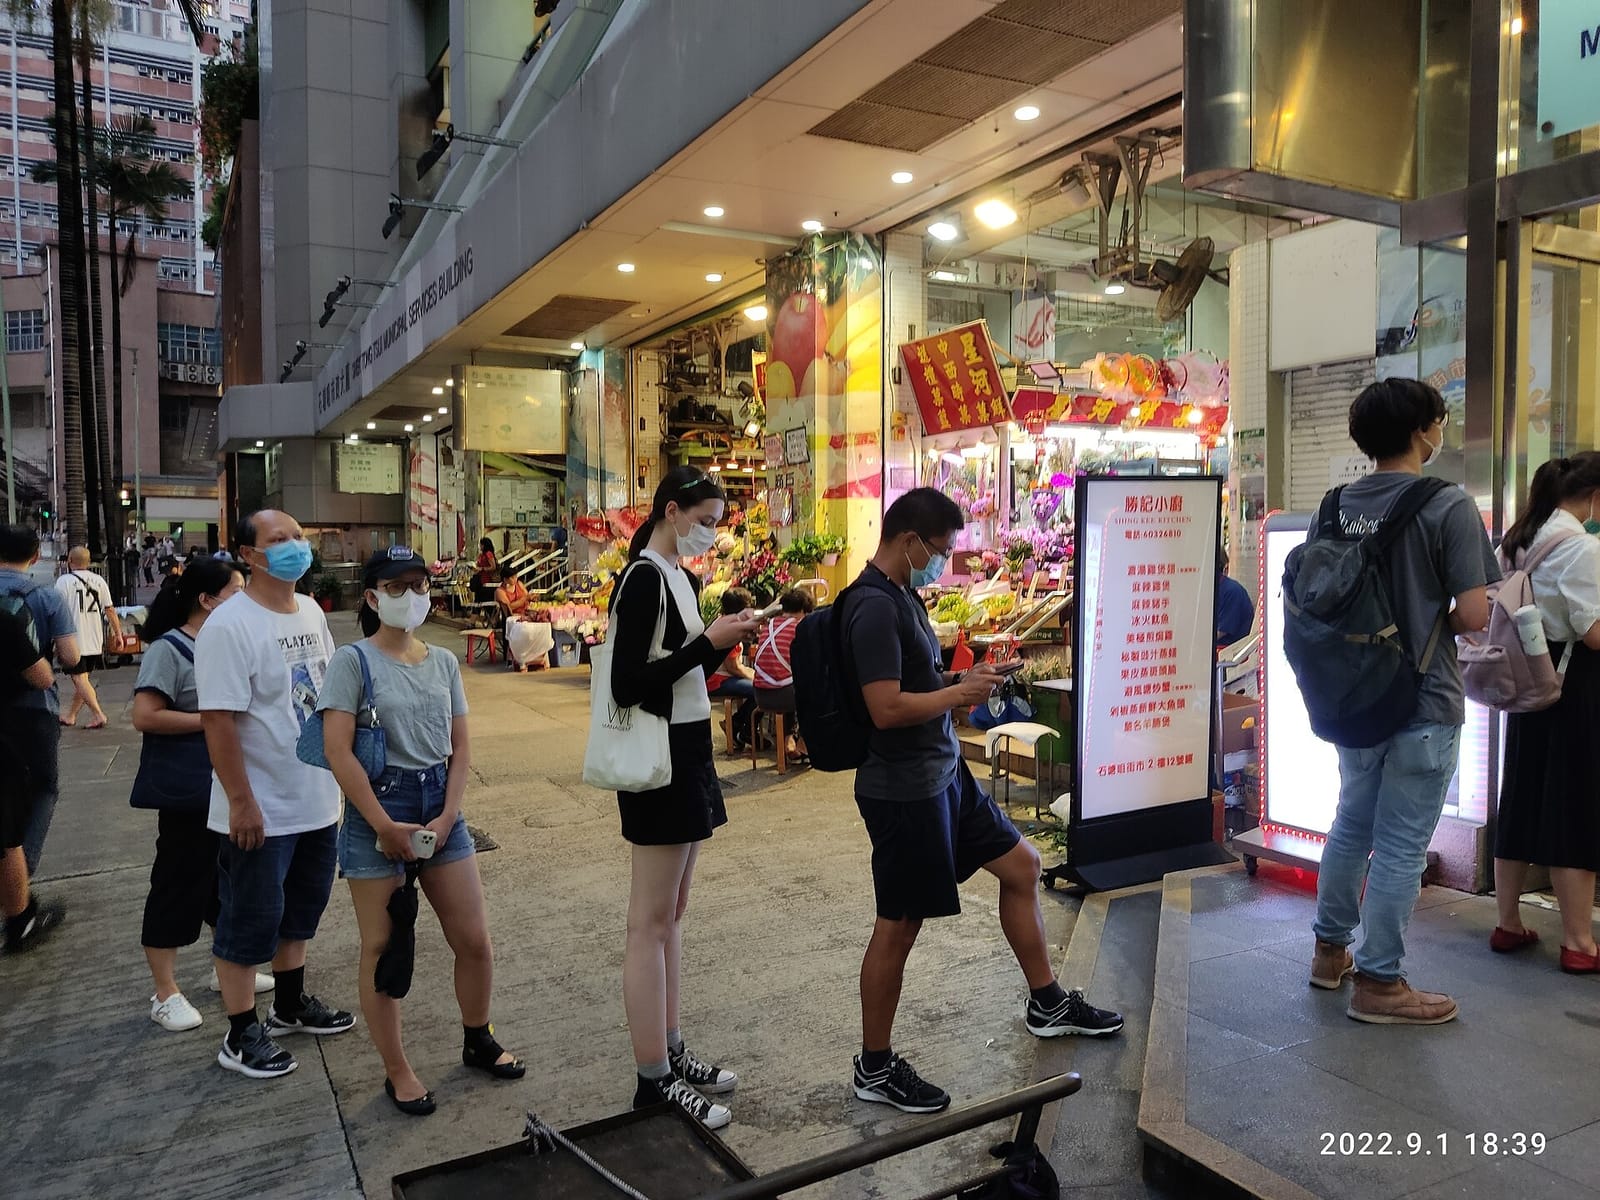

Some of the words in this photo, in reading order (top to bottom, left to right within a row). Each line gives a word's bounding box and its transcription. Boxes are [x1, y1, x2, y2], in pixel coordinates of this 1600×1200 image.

[383, 313, 408, 349] MUNICIPAL
[408, 281, 438, 327] SERVICES
[438, 247, 474, 301] BUILDING
[1125, 495, 1183, 513] 勝記小廚
[1158, 516, 1192, 524] KITCHEN
[76, 588, 99, 613] 12
[1148, 758, 1154, 769] 2
